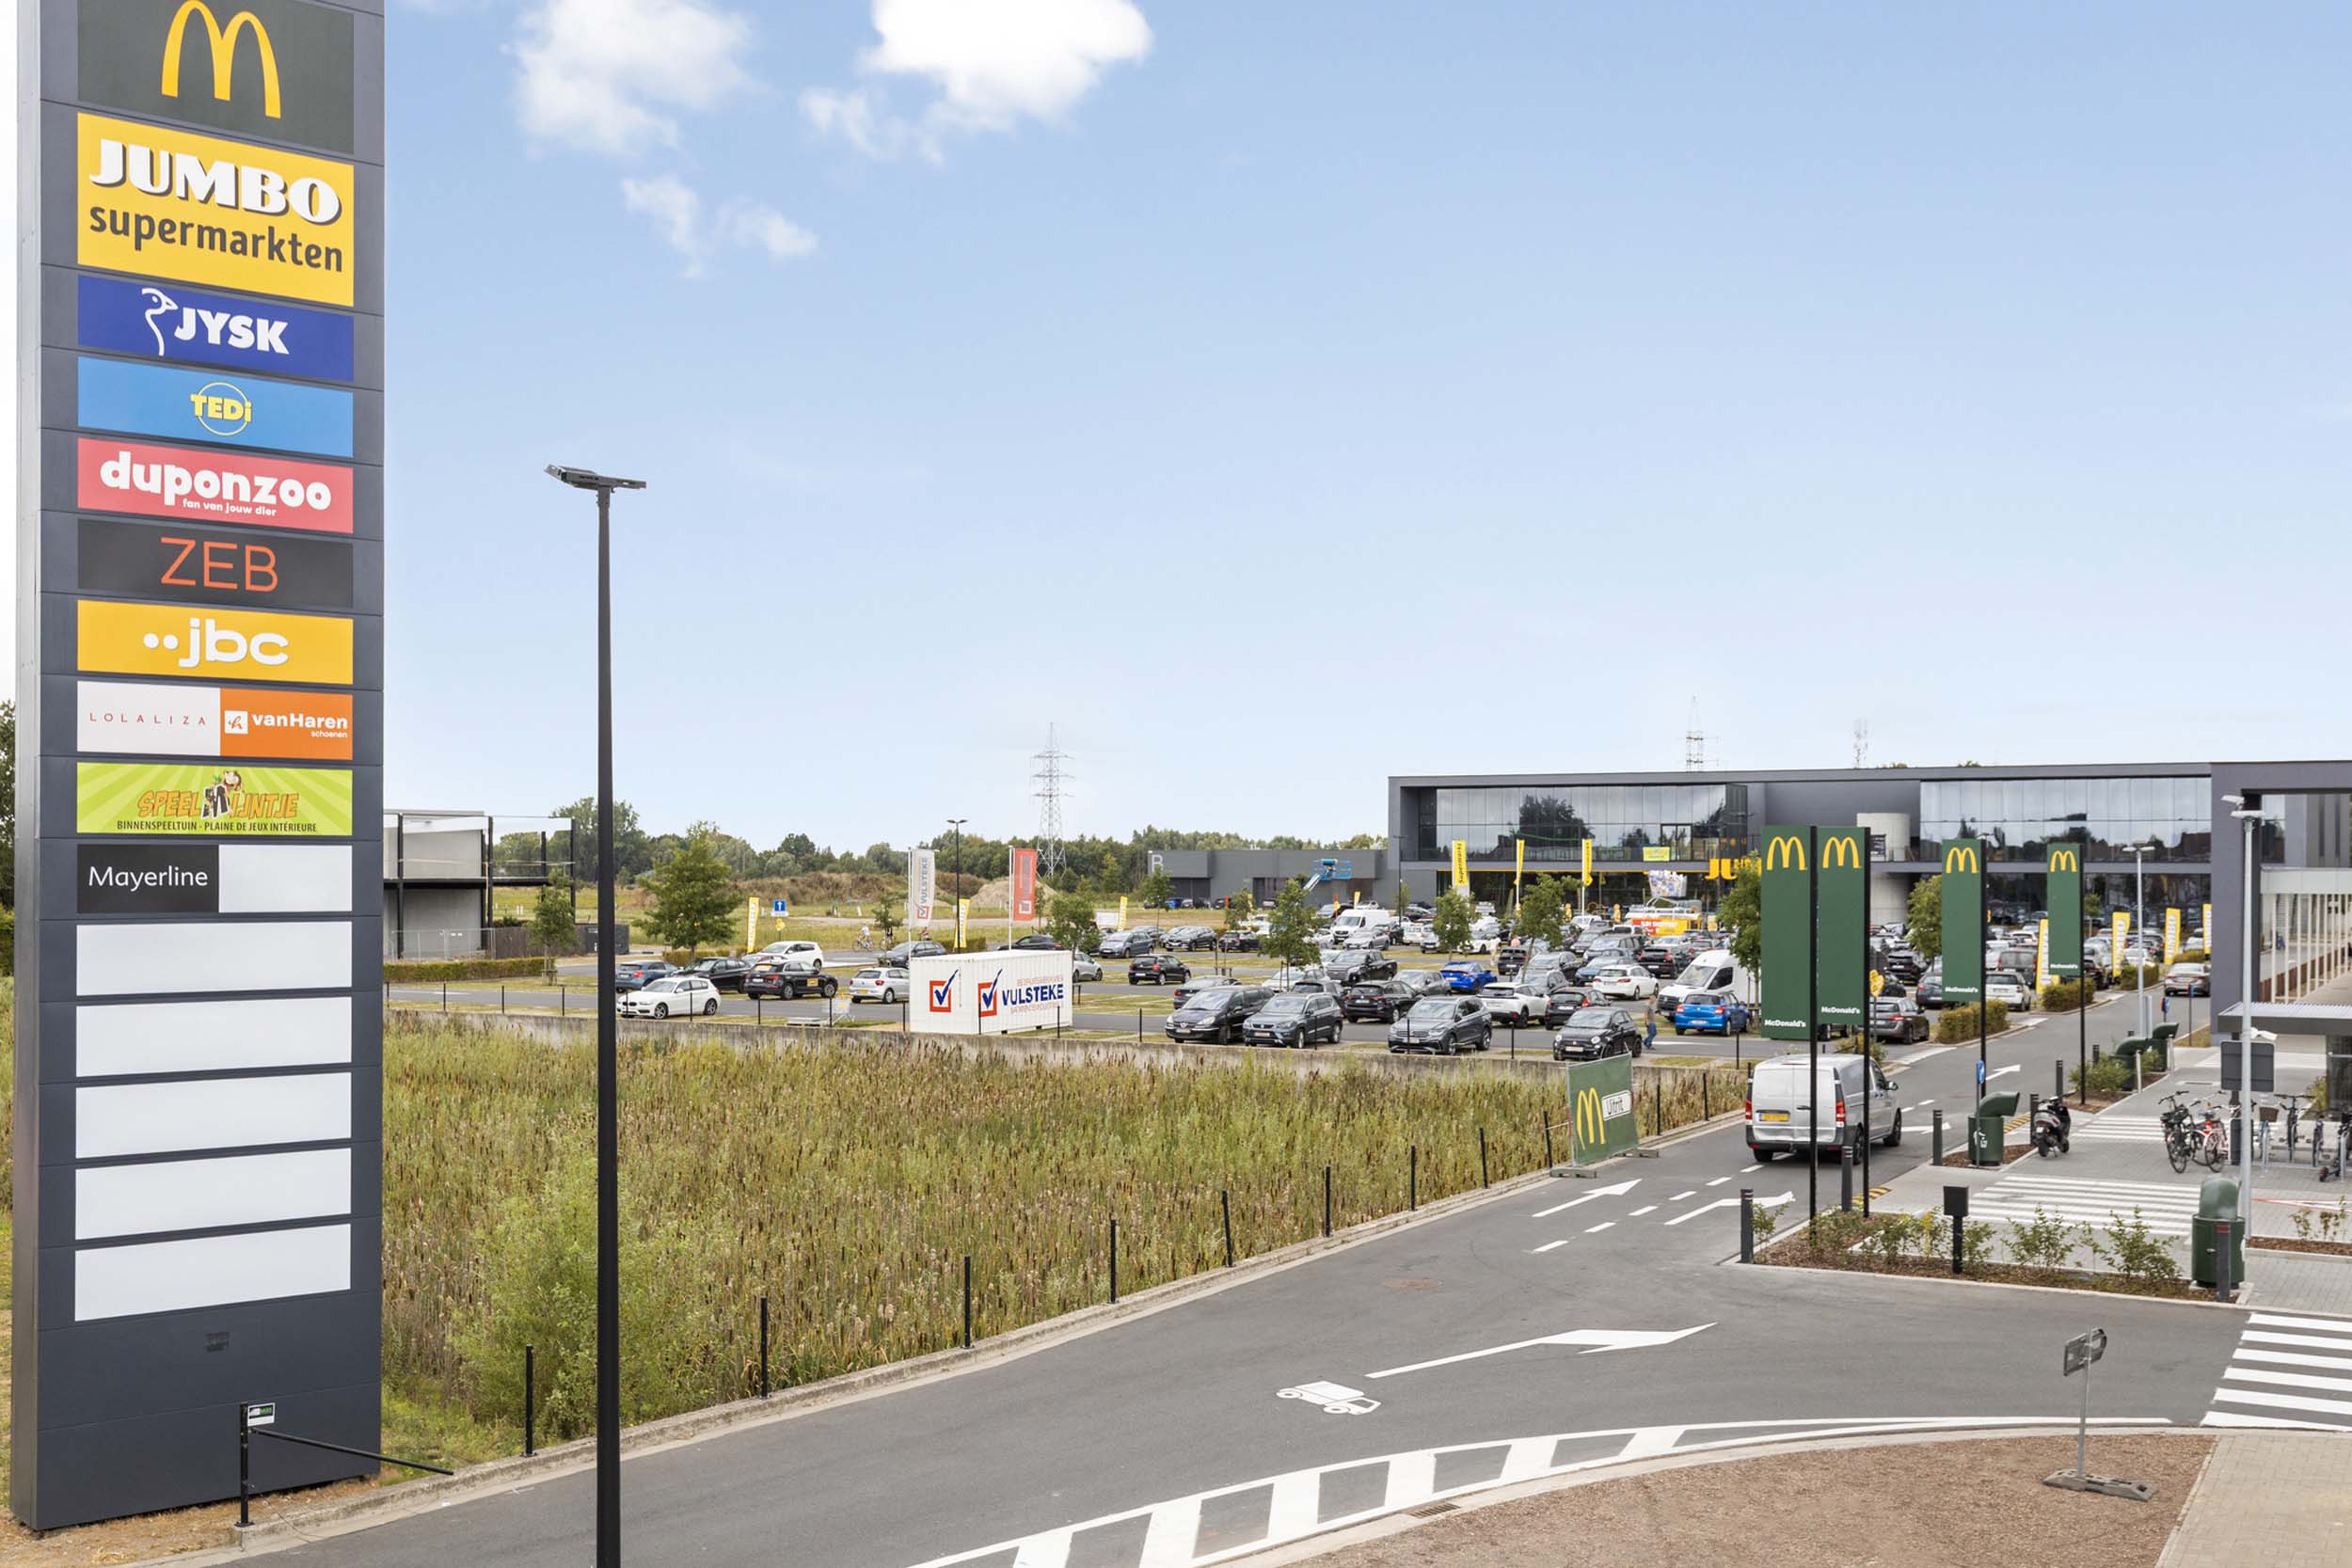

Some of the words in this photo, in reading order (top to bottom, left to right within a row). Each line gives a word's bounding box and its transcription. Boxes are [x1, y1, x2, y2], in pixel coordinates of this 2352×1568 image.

[89, 136, 342, 225] JUMBO
[89, 205, 342, 273] supermarkten
[174, 307, 290, 356] JYSK
[190, 393, 253, 423] TEDi
[100, 451, 332, 510] duponzoo
[183, 498, 200, 509] fan
[203, 501, 223, 512] van
[226, 502, 252, 515] jouw
[255, 506, 278, 516] dier
[159, 536, 278, 593] ZEB
[178, 617, 289, 668] jbc
[89, 712, 206, 725] LOLALIZA
[310, 730, 348, 738] schoenen
[117, 820, 197, 831] BINNENSPEELTUIN
[204, 821, 234, 832] PLAINE
[236, 822, 247, 832] DE
[248, 822, 268, 832] JEUX
[88, 865, 208, 896] Mayerline
[1002, 983, 1064, 1006] VULSTEKE
[1764, 1019, 1806, 1028] McDonald's
[1820, 1006, 1861, 1014] McDonald's
